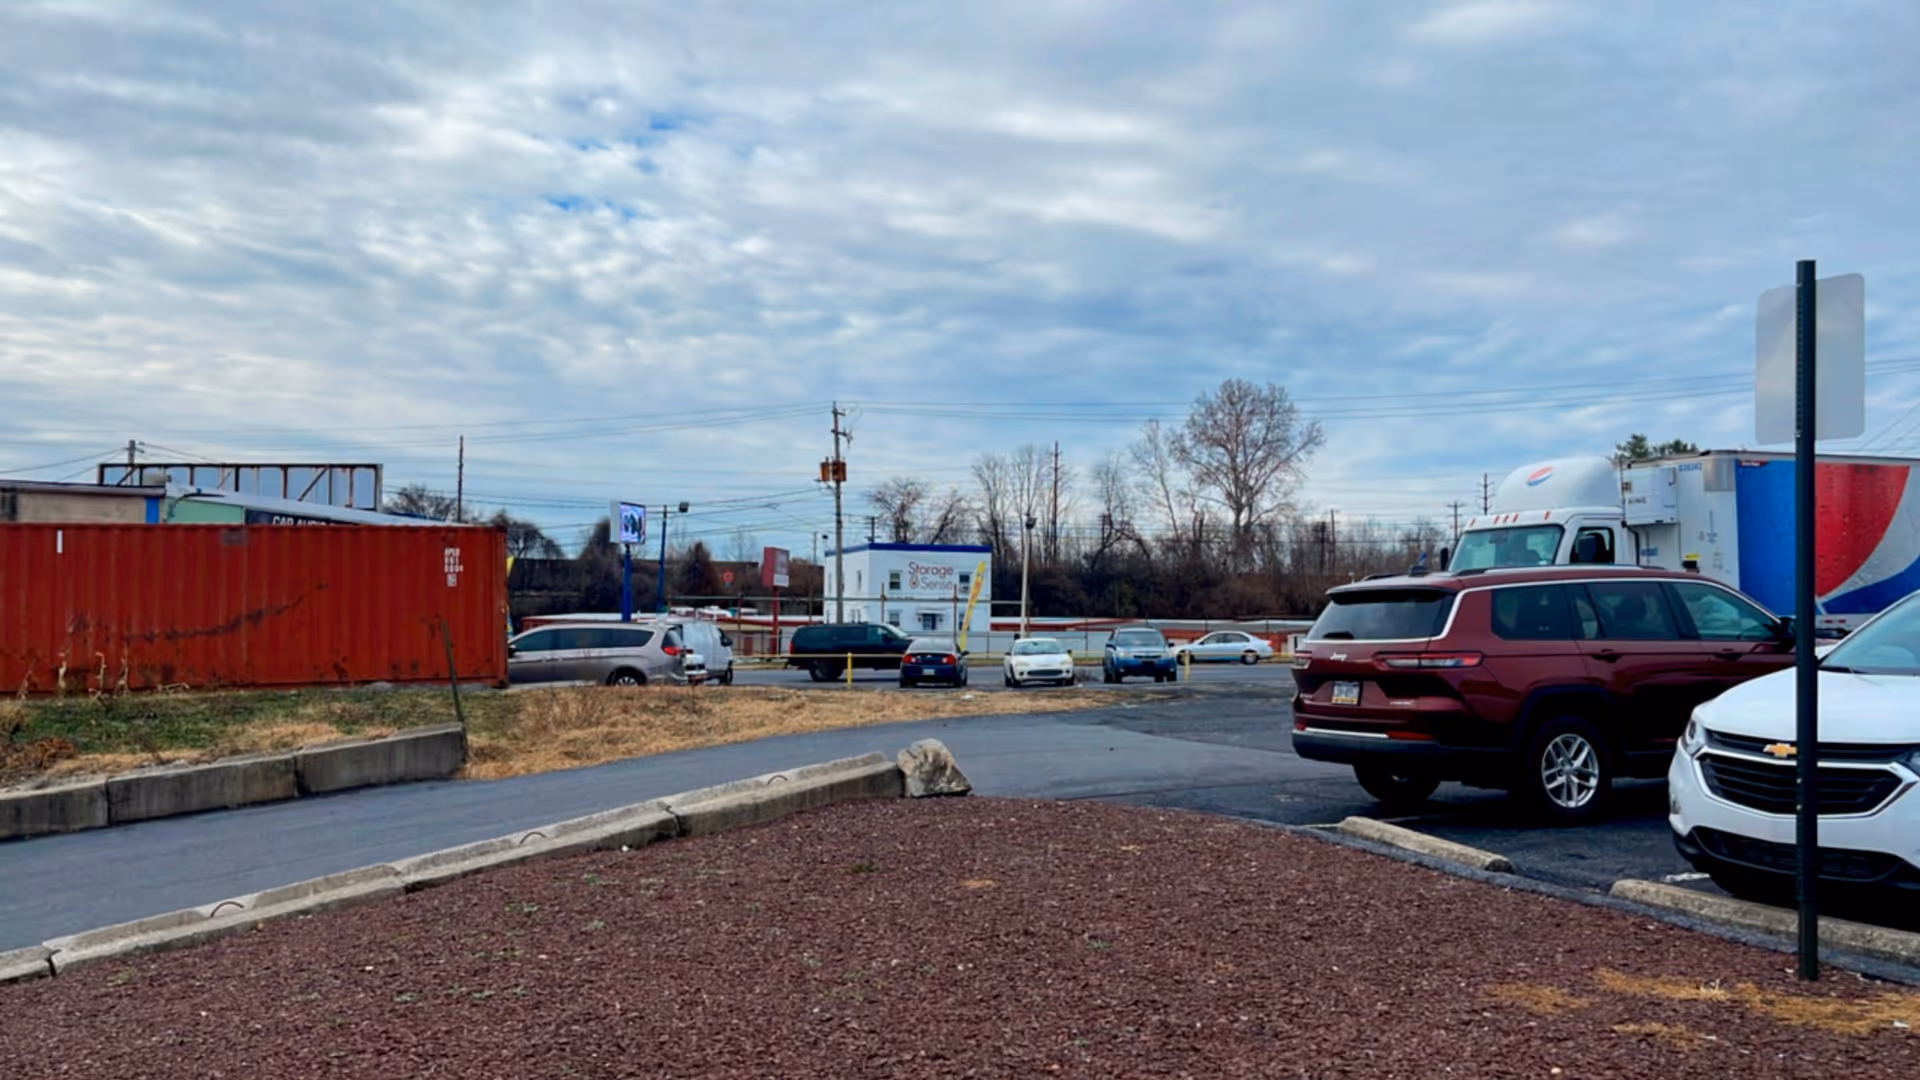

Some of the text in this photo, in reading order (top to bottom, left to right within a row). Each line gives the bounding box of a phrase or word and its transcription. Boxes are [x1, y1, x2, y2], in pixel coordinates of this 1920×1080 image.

[908, 561, 954, 579] Storage
[920, 576, 954, 590] Sense
[1330, 651, 1347, 662] Jeep
